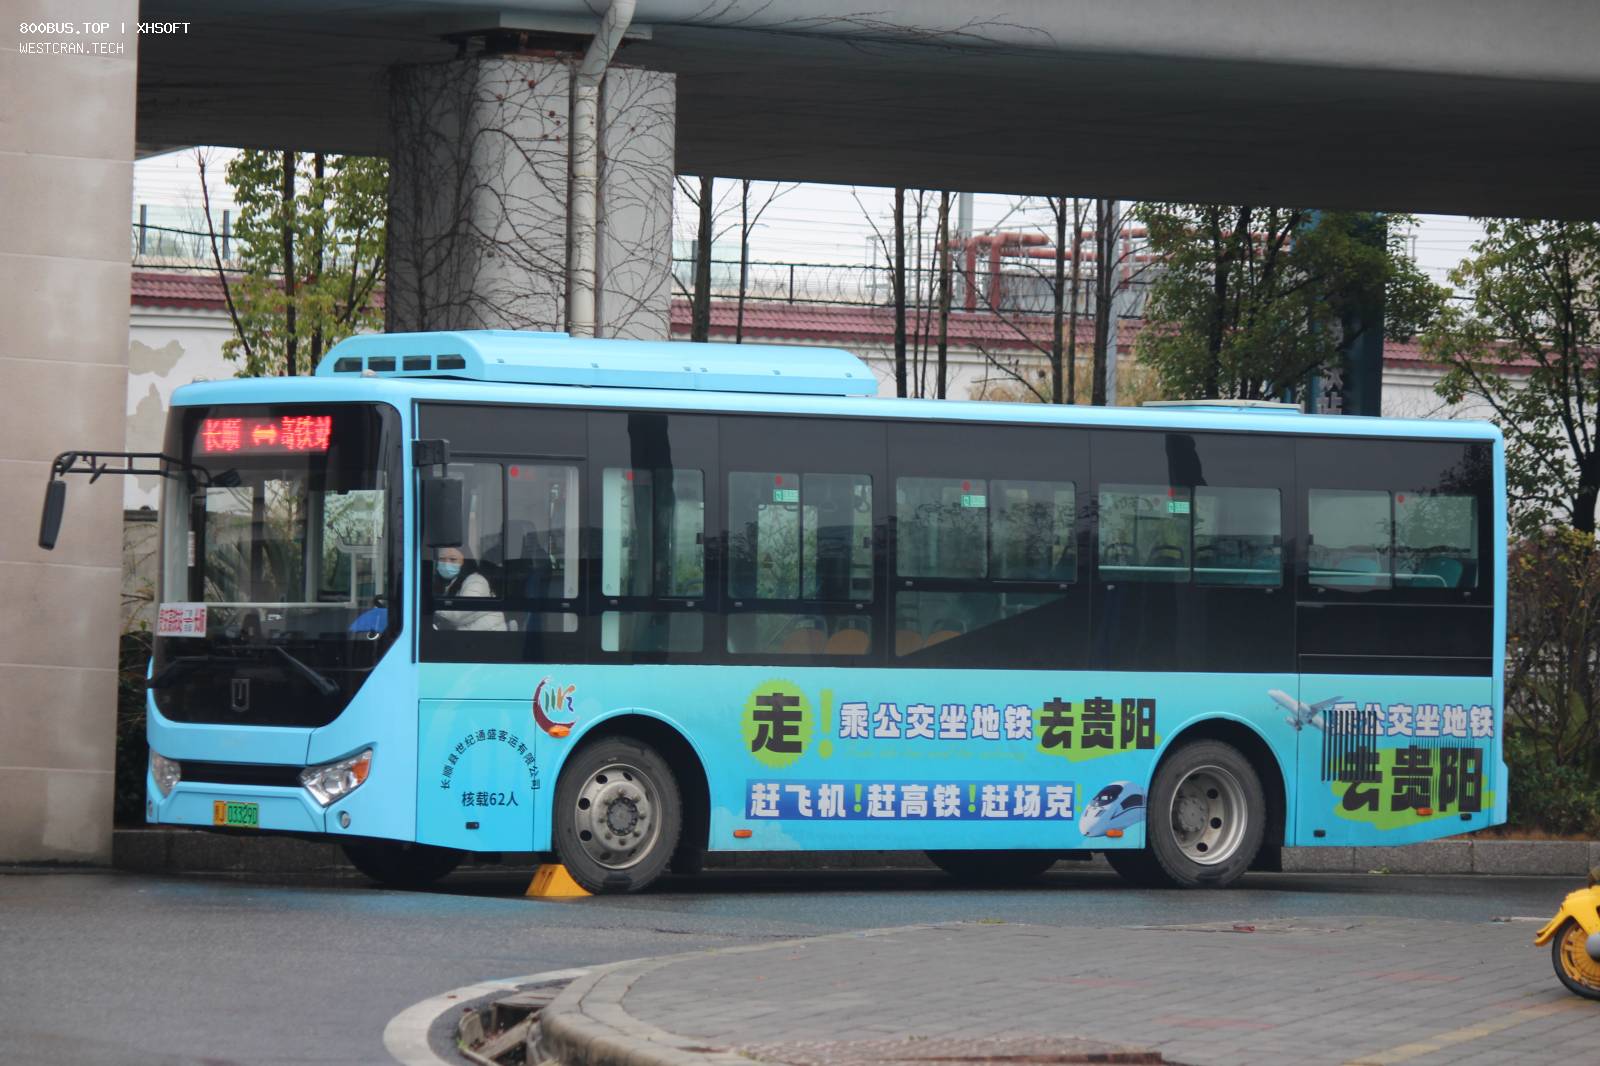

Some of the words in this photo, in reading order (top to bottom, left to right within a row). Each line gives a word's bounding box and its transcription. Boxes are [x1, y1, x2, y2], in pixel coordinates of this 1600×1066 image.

[838, 701, 1034, 742] 乘公交坐地铁
[1040, 697, 1156, 750] 去贵阳
[461, 791, 519, 807] 核载62人
[1341, 745, 1484, 813] 去贵阳
